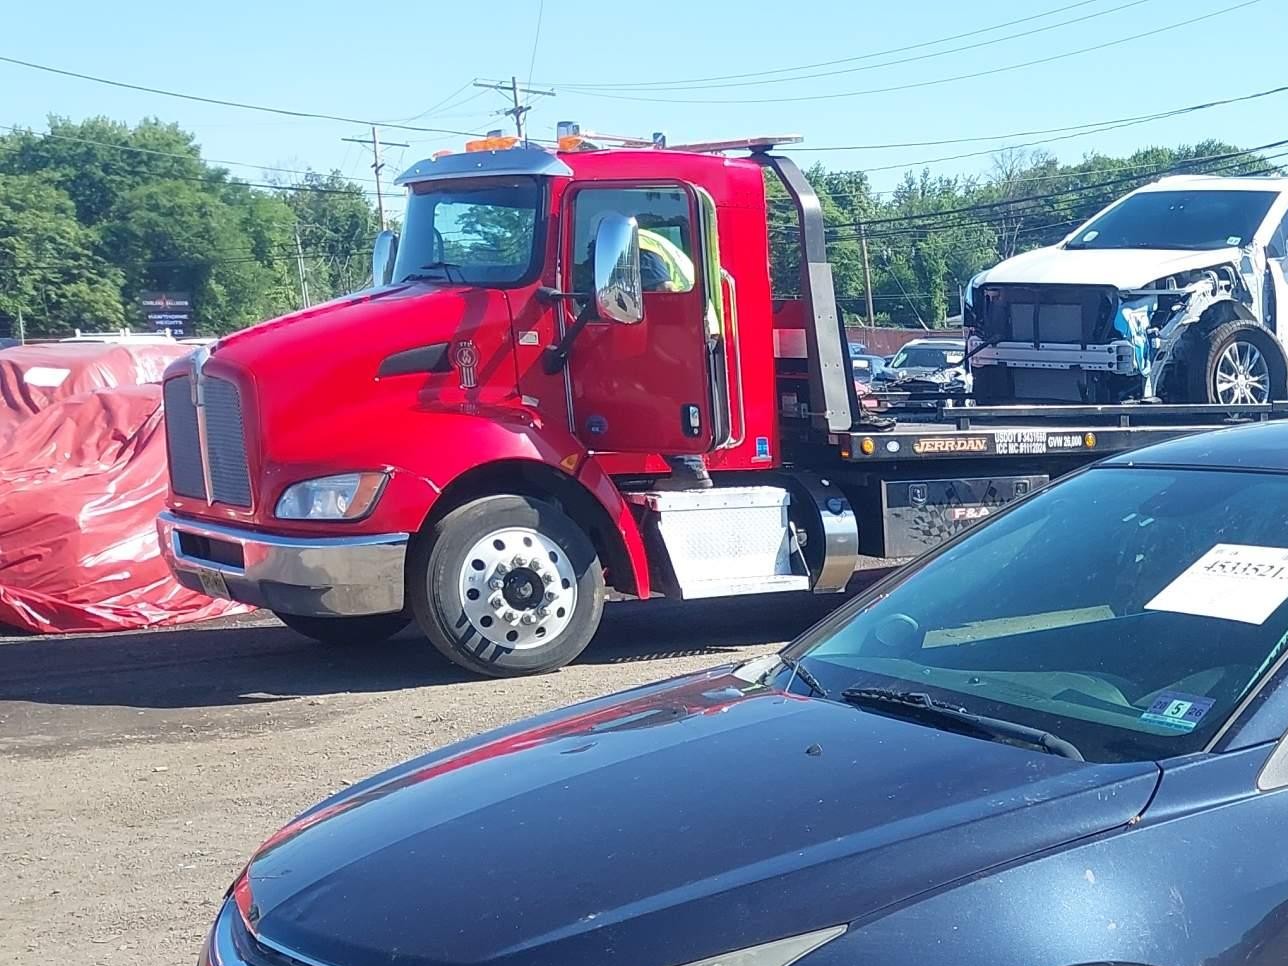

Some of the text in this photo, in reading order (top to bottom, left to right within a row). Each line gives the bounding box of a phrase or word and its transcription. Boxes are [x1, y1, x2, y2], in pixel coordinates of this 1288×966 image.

[913, 438, 987, 453] JERR-DAN
[1047, 436, 1082, 448] GVW 26,000
[1171, 703, 1184, 715] 5
